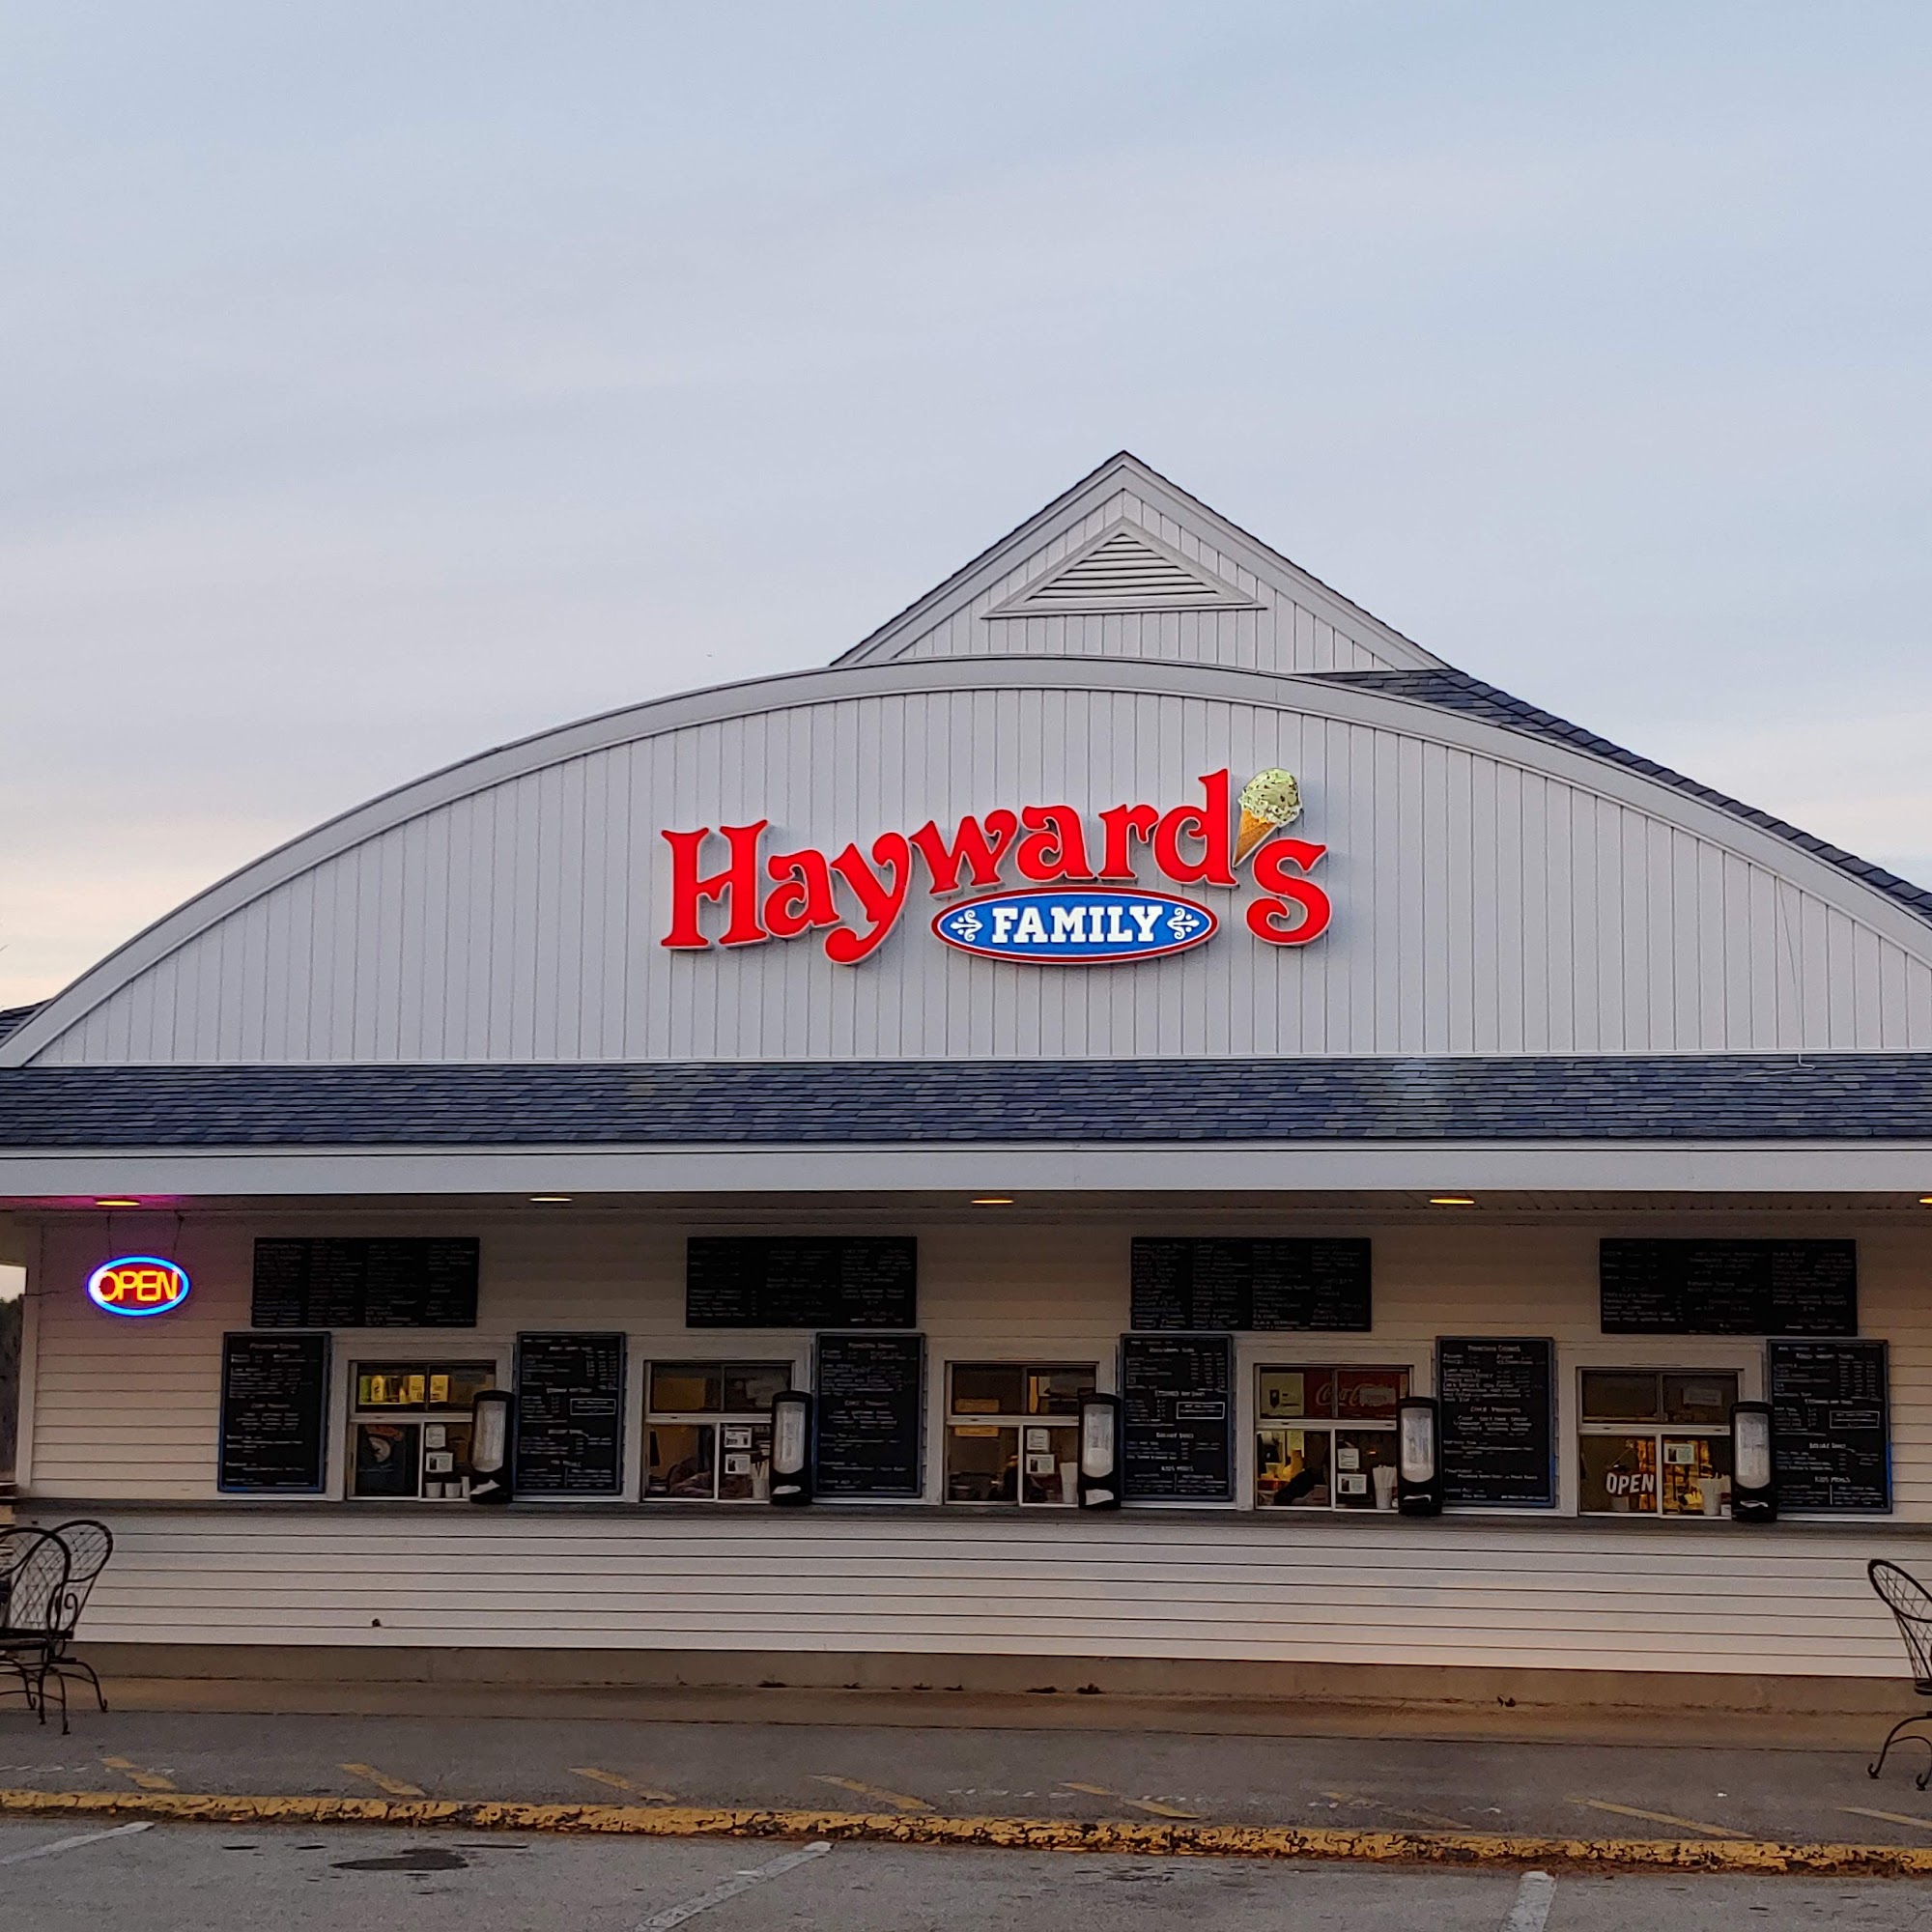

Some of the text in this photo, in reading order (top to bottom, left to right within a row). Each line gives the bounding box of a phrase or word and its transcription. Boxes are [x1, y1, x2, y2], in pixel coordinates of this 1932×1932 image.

[992, 905, 1162, 944] FAMILY
[99, 1270, 178, 1301] OPEN
[1605, 1472, 1654, 1495] OPEN
